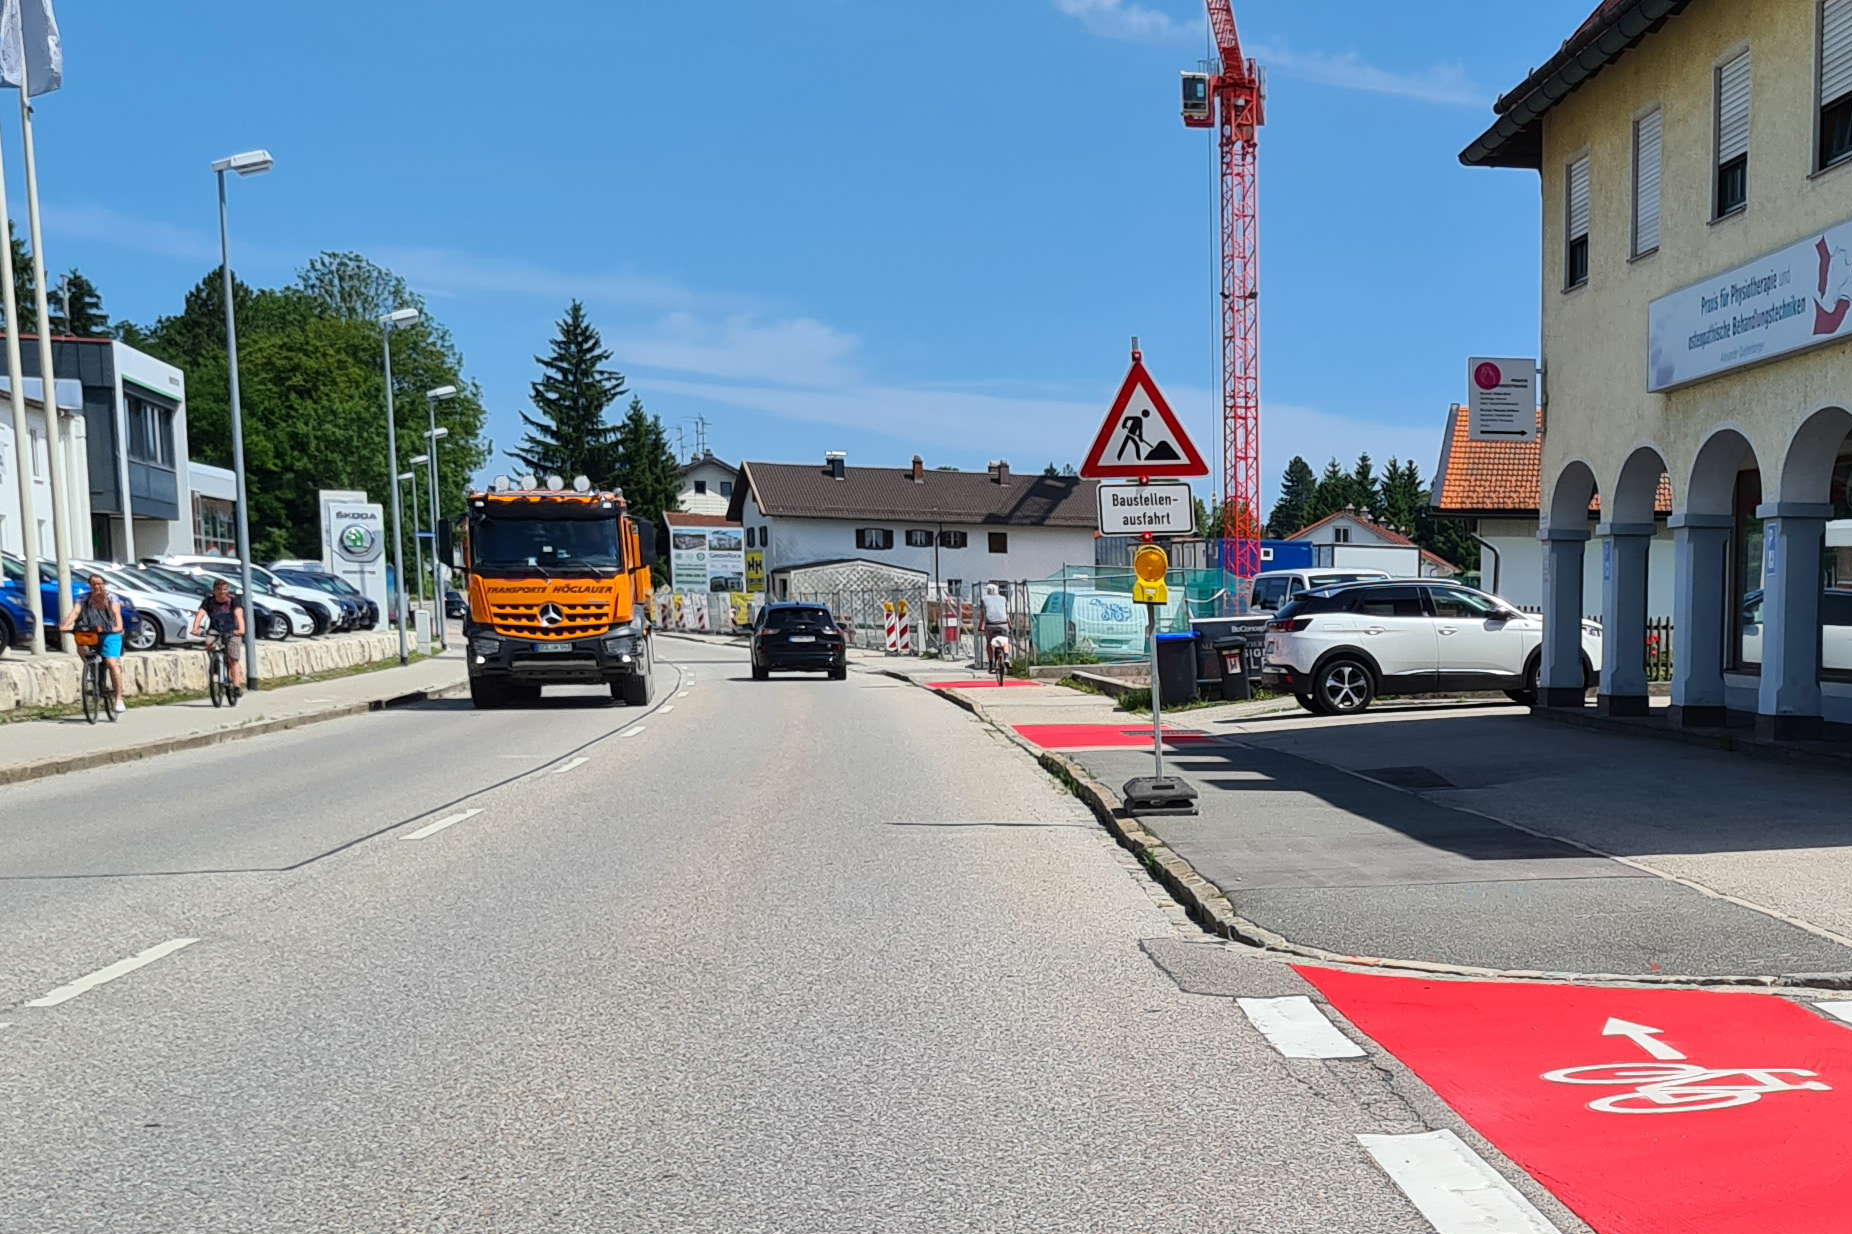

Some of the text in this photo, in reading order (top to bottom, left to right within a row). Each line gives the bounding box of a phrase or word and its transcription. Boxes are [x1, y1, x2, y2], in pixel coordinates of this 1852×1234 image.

[1701, 294, 1719, 316] Praxis
[1720, 287, 1730, 308] für
[1730, 268, 1778, 308] Physiotherapie
[1732, 295, 1807, 336] Behandlungstechniken
[1111, 492, 1179, 507] Baustellen-
[335, 510, 378, 520] ŠKODA
[1122, 511, 1172, 526] ausfahrt
[486, 583, 614, 594] TRANSPORTE HÖGLAUER
